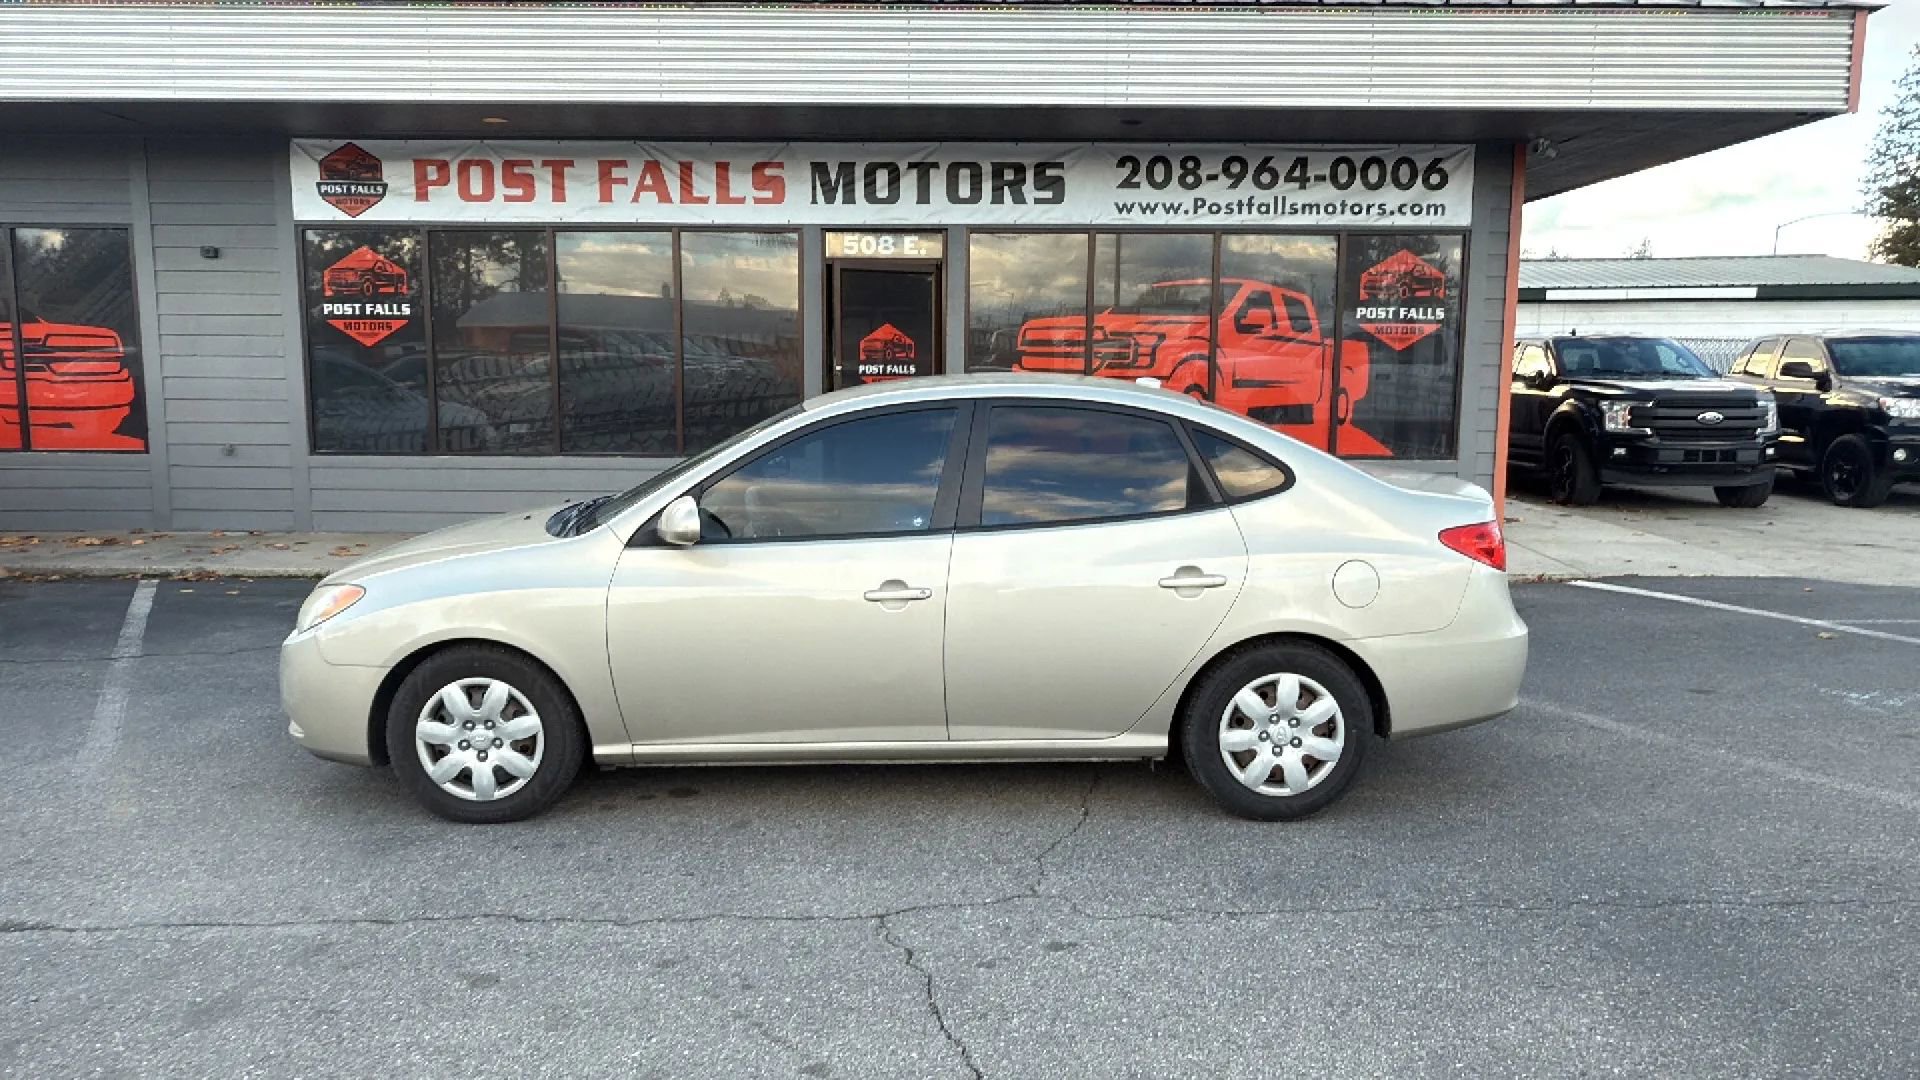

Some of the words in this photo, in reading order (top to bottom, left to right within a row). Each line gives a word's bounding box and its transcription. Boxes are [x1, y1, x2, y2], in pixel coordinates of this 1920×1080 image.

[1115, 155, 1449, 191] 208-964-0006
[413, 159, 575, 202] POST
[597, 160, 787, 204] FALLS
[809, 161, 1066, 205] MOTORS
[321, 184, 348, 194] POST
[351, 185, 383, 194] FALLS
[1114, 196, 1447, 217] www.Postfallsmotors.com
[843, 235, 895, 255] 508
[903, 235, 927, 255] E.
[323, 303, 362, 315] POST
[365, 303, 411, 315] FALLS
[1355, 307, 1396, 319] POST
[1399, 307, 1445, 319] FALLS
[343, 321, 393, 331] MOTORS
[1375, 325, 1425, 335] MOTORS
[858, 364, 883, 375] POST
[886, 364, 916, 375] FALLS
